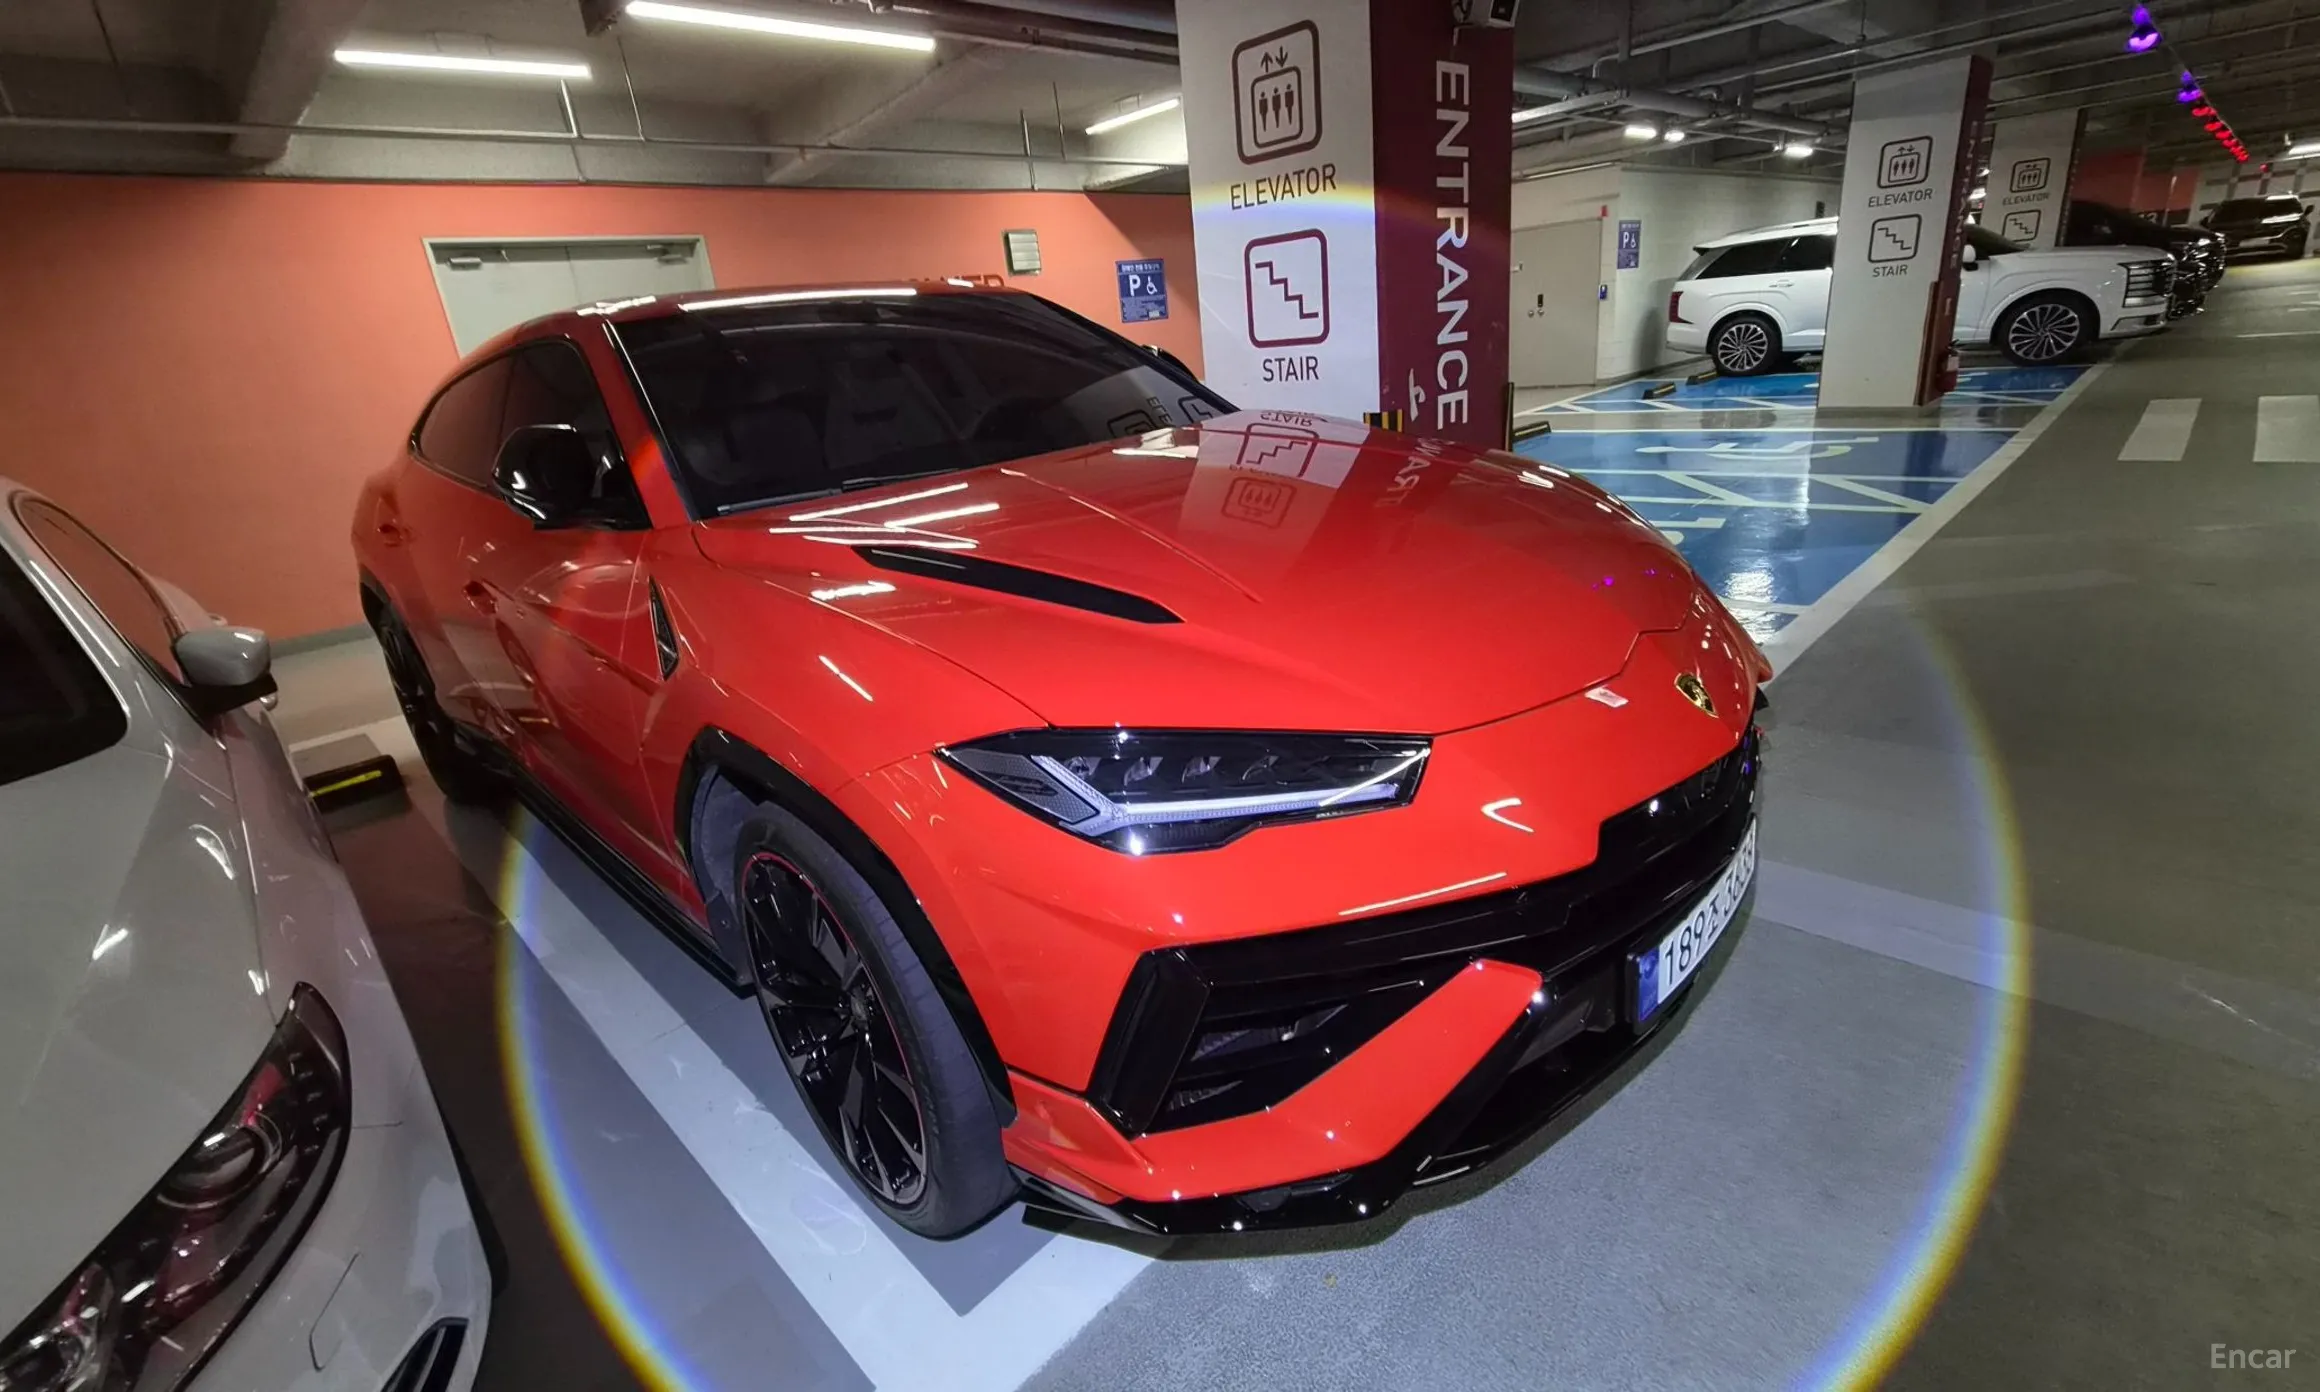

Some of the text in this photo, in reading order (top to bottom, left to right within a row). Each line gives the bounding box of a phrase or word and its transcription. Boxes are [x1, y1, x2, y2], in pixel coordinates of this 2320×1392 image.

[1230, 162, 1337, 211] ELEVATOR
[1868, 187, 1934, 208] ELEVATOR
[2002, 192, 2050, 206] ELEVATOR
[1436, 60, 1469, 431] ENTRANCE
[1622, 231, 1630, 249] P
[1872, 264, 1909, 278] STAIR
[1128, 274, 1141, 297] P
[1262, 355, 1320, 382] STAIR
[1665, 894, 1720, 985] 189조
